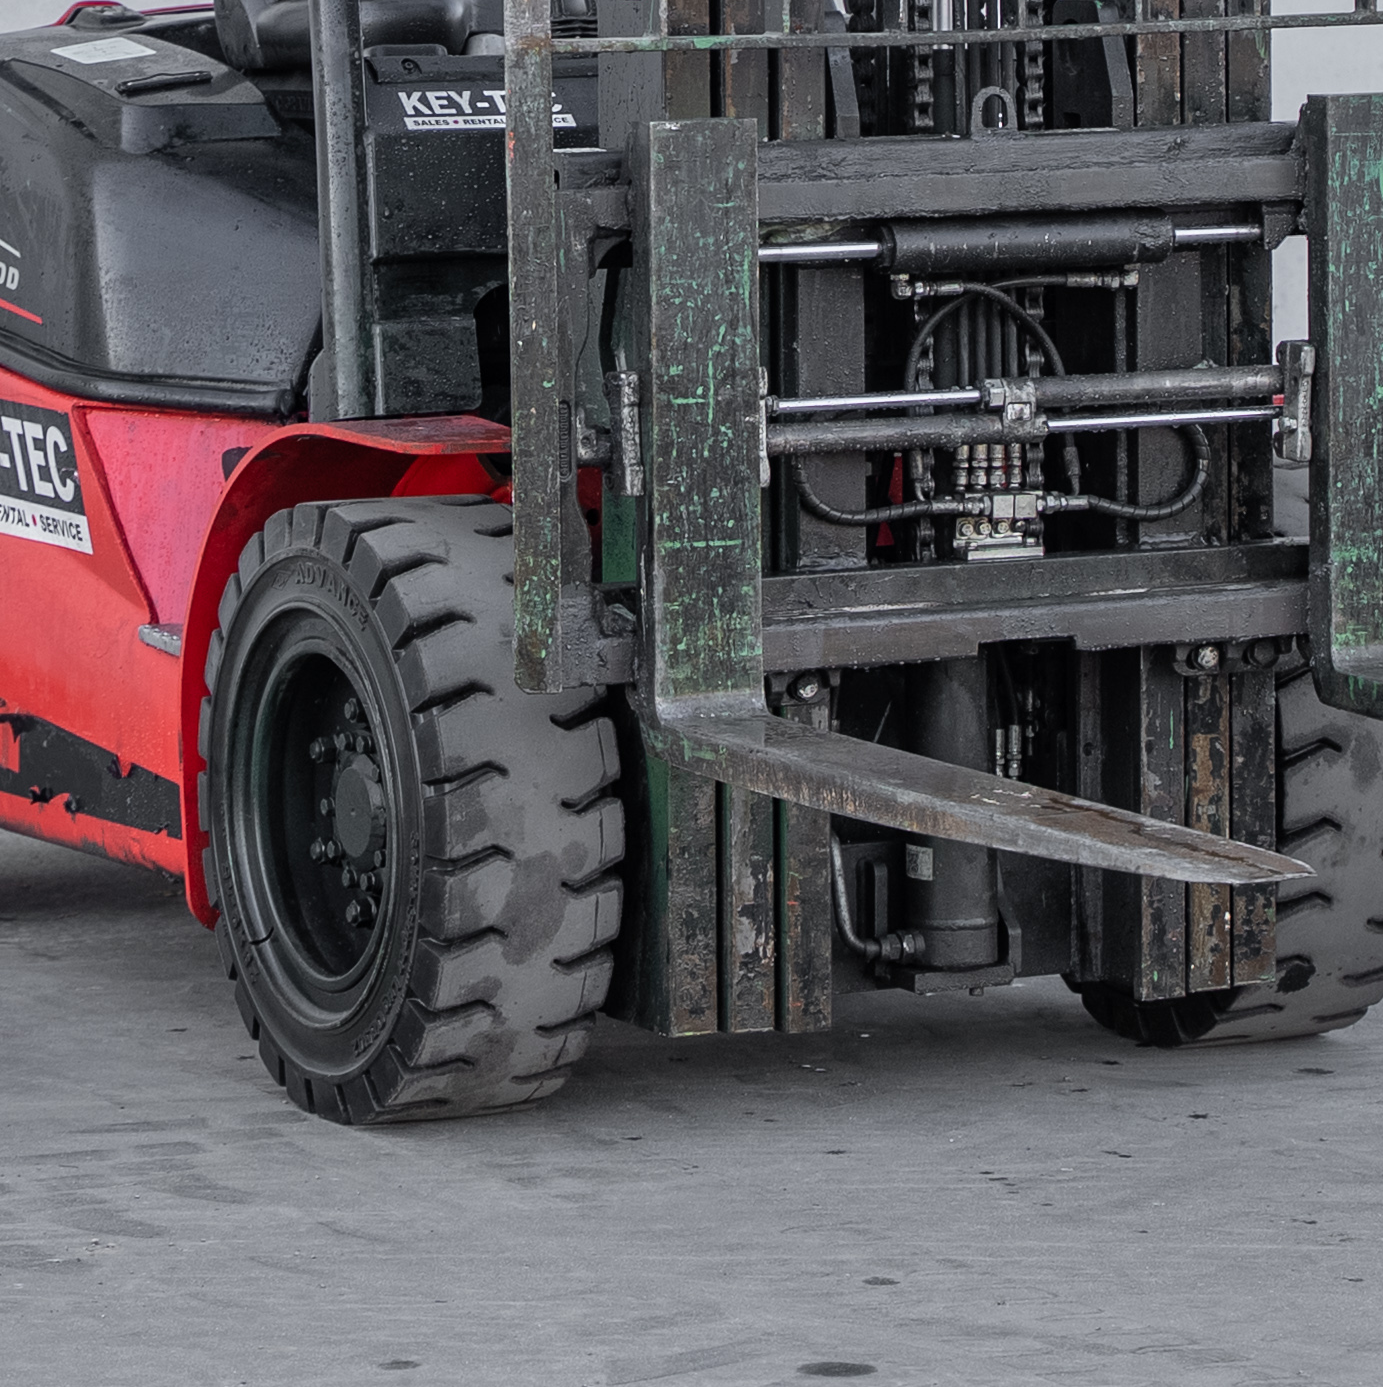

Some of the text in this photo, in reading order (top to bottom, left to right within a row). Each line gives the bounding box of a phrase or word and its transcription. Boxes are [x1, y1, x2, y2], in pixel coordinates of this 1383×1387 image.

[398, 90, 563, 115] KEY-T
[412, 119, 450, 127] SALES
[39, 513, 84, 542] SERVICE
